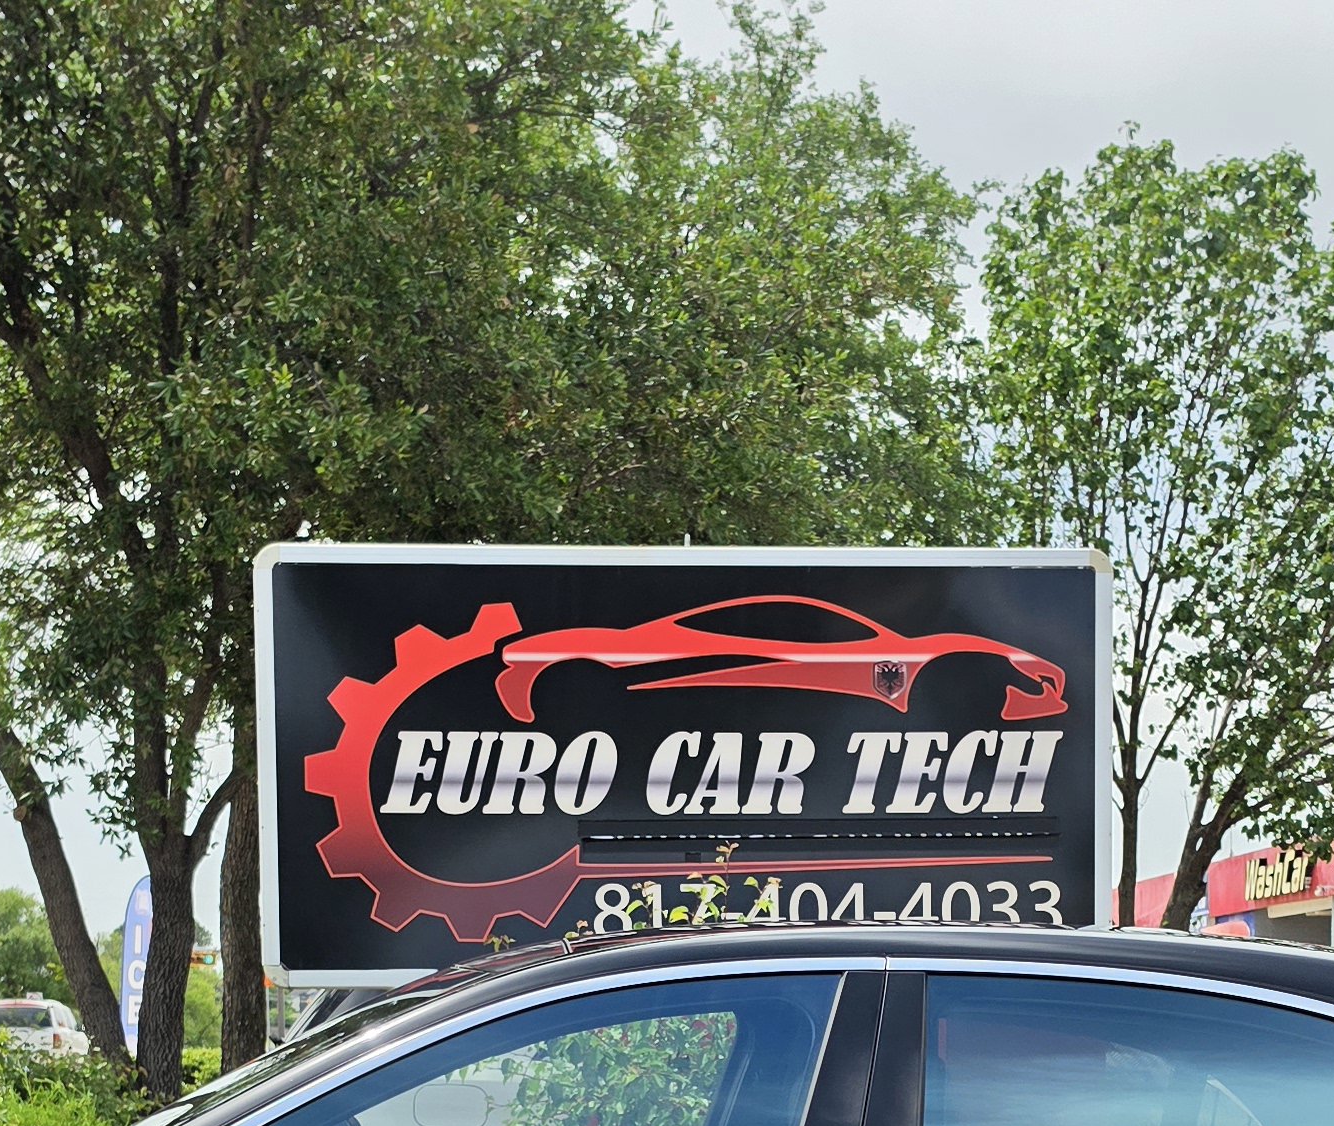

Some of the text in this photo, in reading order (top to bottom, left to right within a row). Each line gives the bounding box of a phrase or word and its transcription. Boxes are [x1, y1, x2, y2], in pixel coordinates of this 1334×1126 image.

[379, 729, 1064, 816] EURO CAR TECH
[1244, 848, 1309, 902] WashCar
